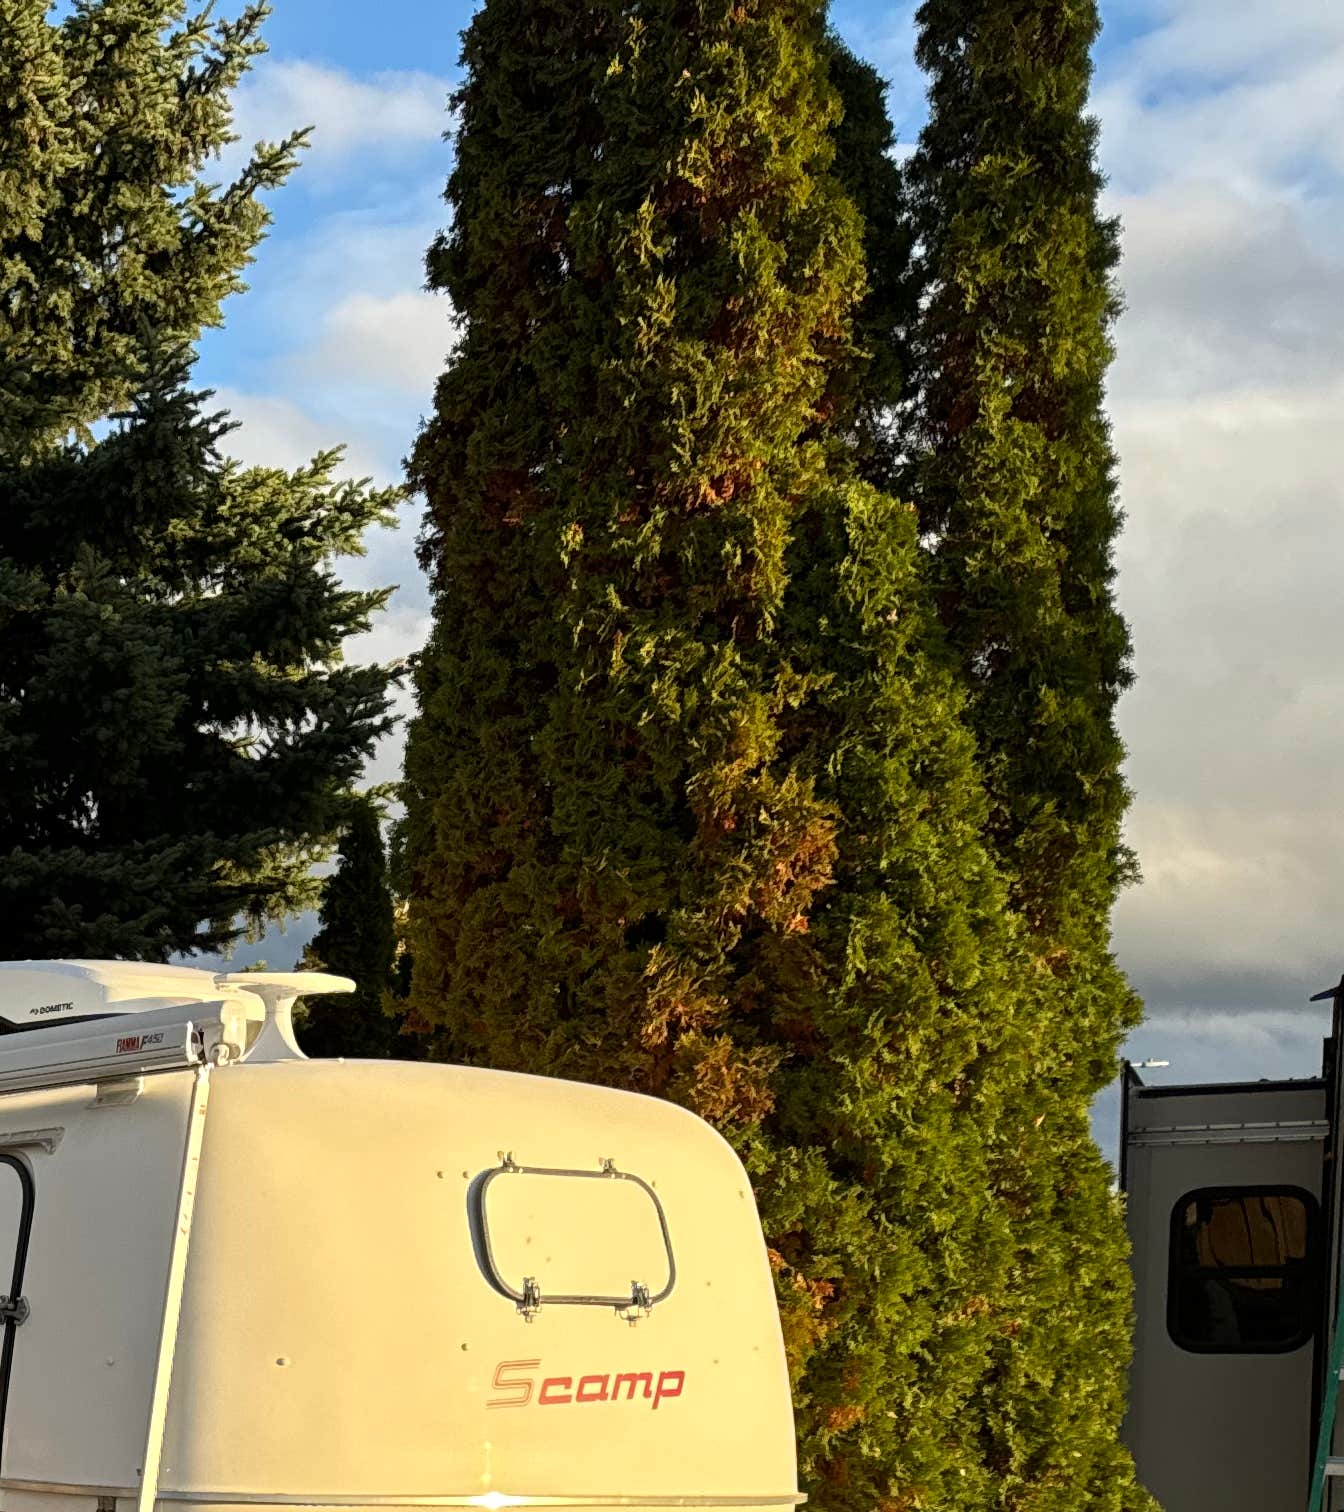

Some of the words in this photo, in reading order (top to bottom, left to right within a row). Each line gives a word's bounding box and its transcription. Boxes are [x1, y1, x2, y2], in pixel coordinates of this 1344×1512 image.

[39, 1002, 74, 1015] DOMETIC
[116, 1036, 140, 1054] FIAMMA
[485, 1358, 686, 1410] Scamp
